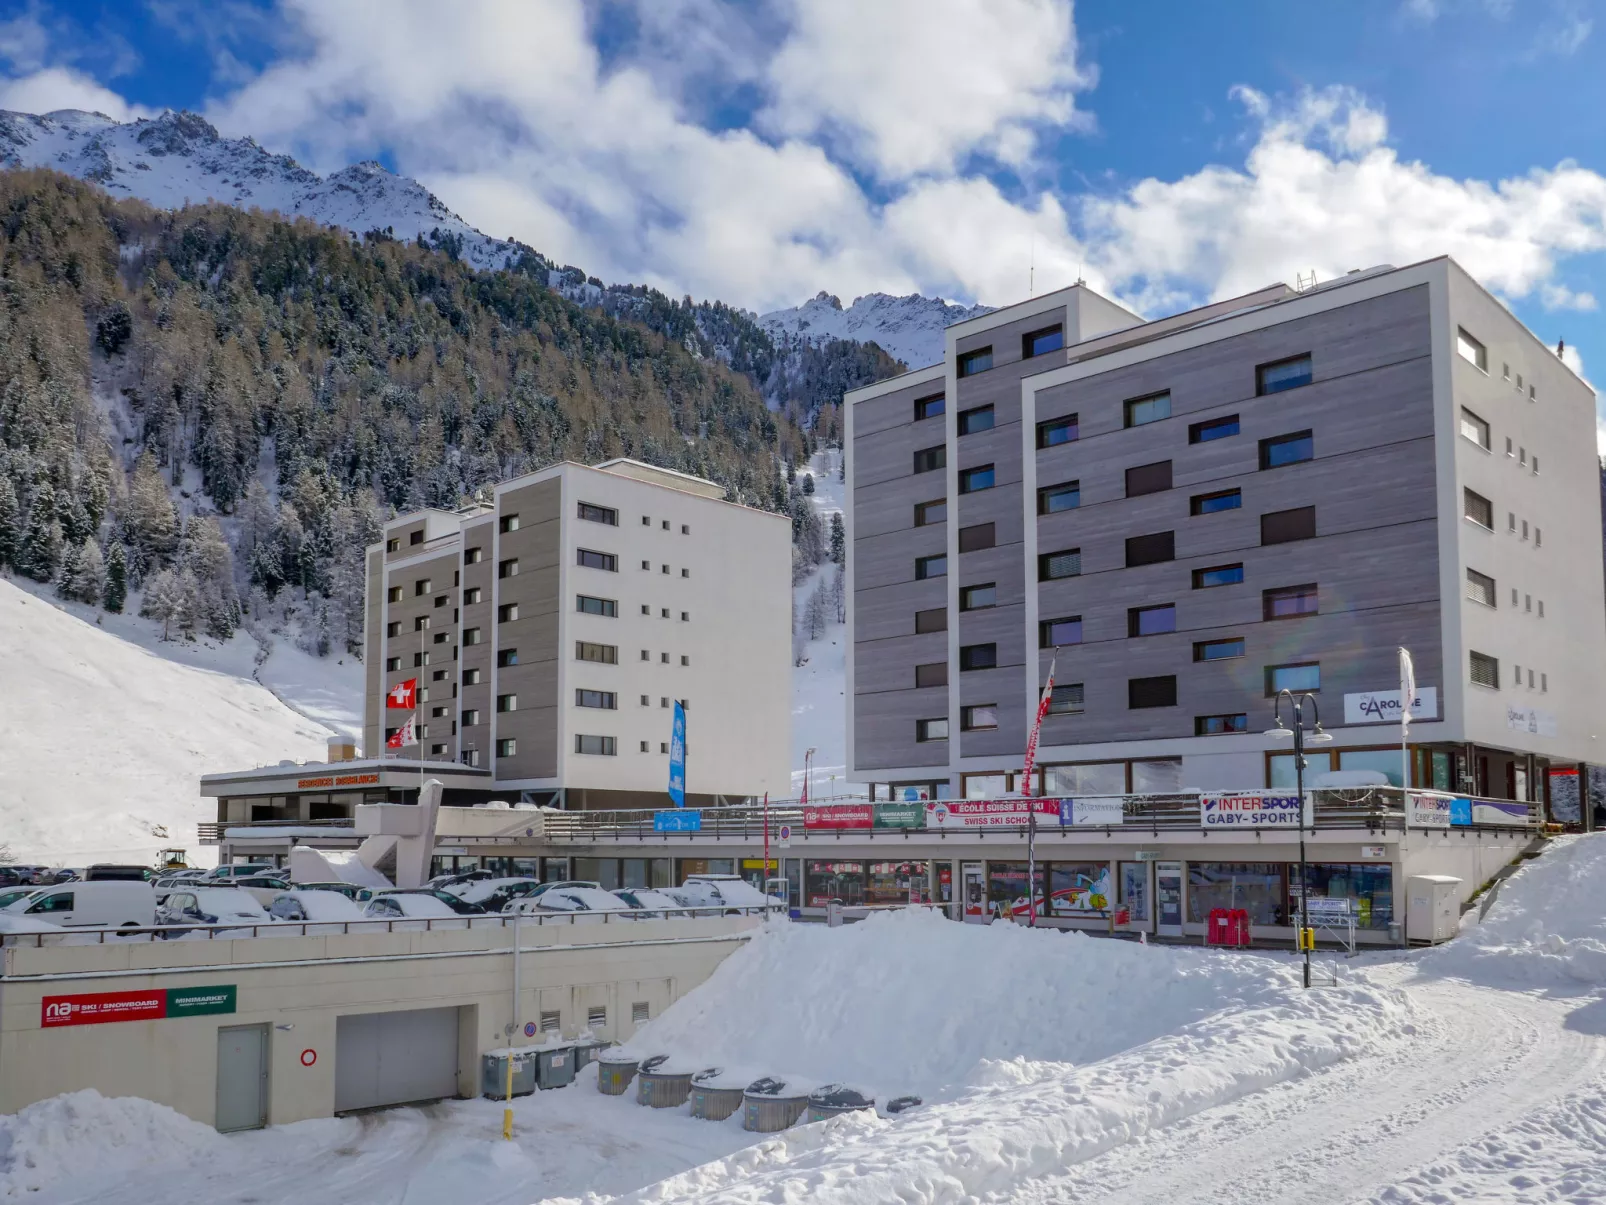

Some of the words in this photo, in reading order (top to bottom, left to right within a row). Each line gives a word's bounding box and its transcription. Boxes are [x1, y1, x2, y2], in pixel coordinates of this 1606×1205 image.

[1359, 696, 1421, 720] CAROLE
[964, 817, 987, 825] SWISS
[990, 817, 1003, 825] SKI
[103, 999, 159, 1009] SNOWBOARD
[175, 994, 228, 1004] MINIMARKET
